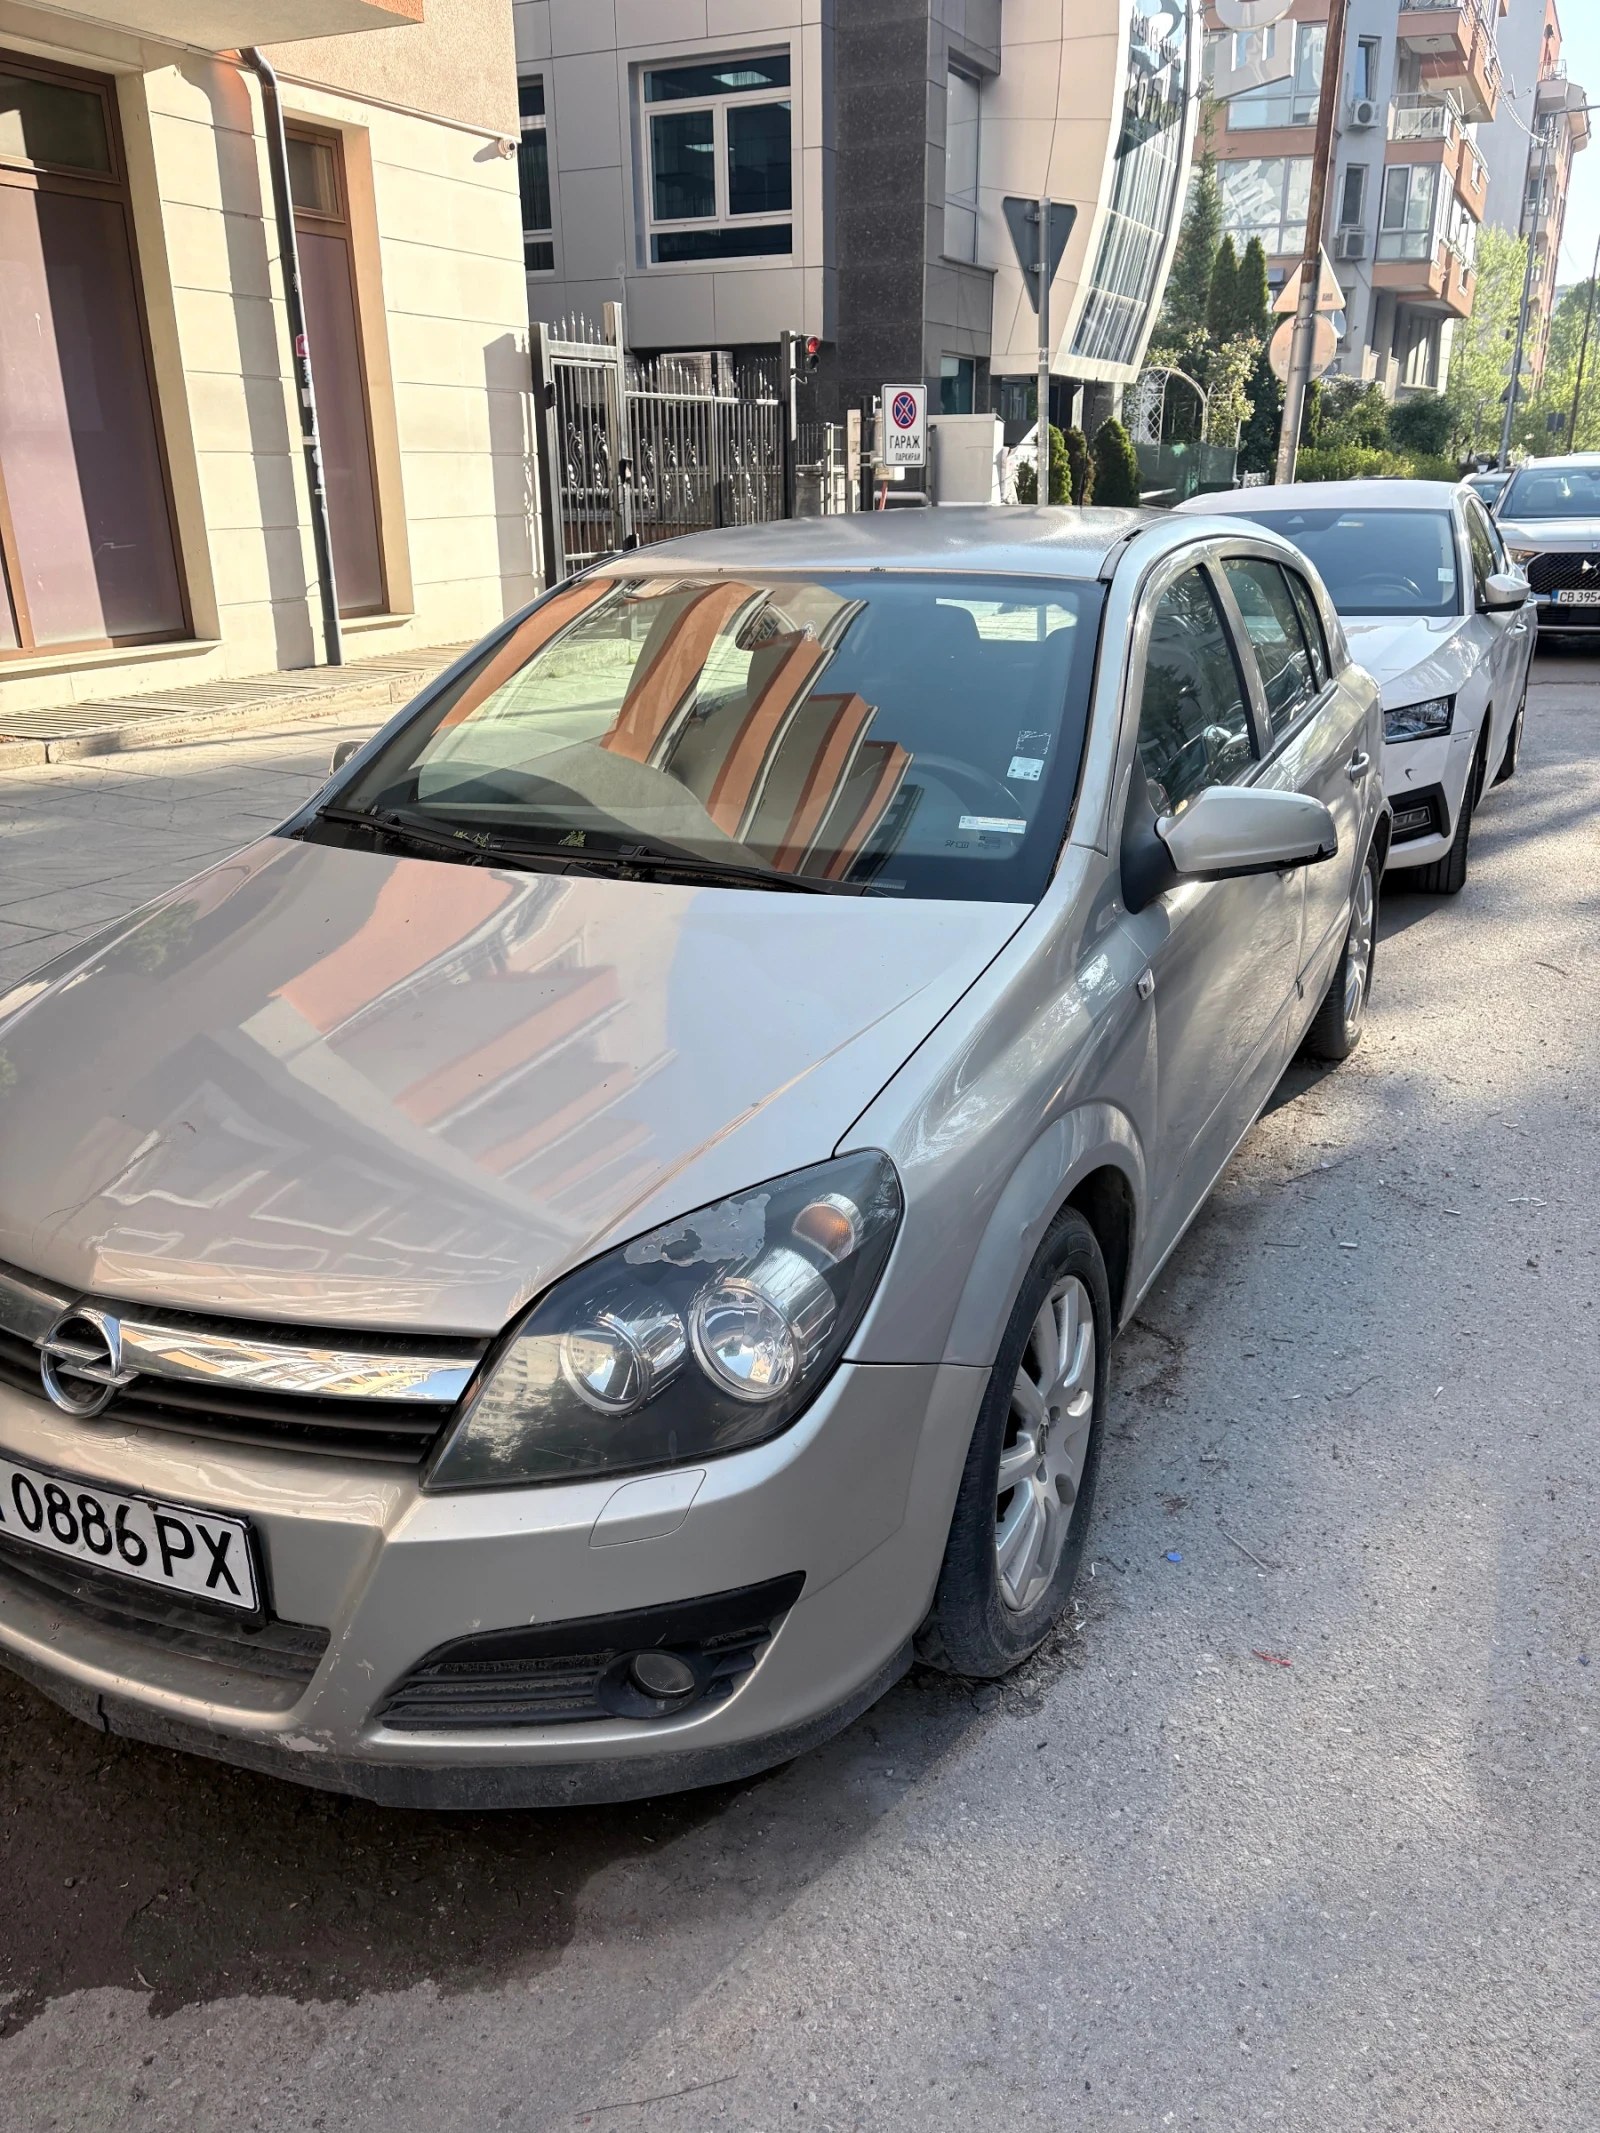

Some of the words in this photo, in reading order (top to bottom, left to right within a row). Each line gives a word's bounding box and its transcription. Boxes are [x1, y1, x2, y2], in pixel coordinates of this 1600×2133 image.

[889, 435, 920, 448] ГАРАЖ
[1576, 591, 1600, 603] 395
[11, 1472, 148, 1567] 0886
[153, 1513, 242, 1596] PX
